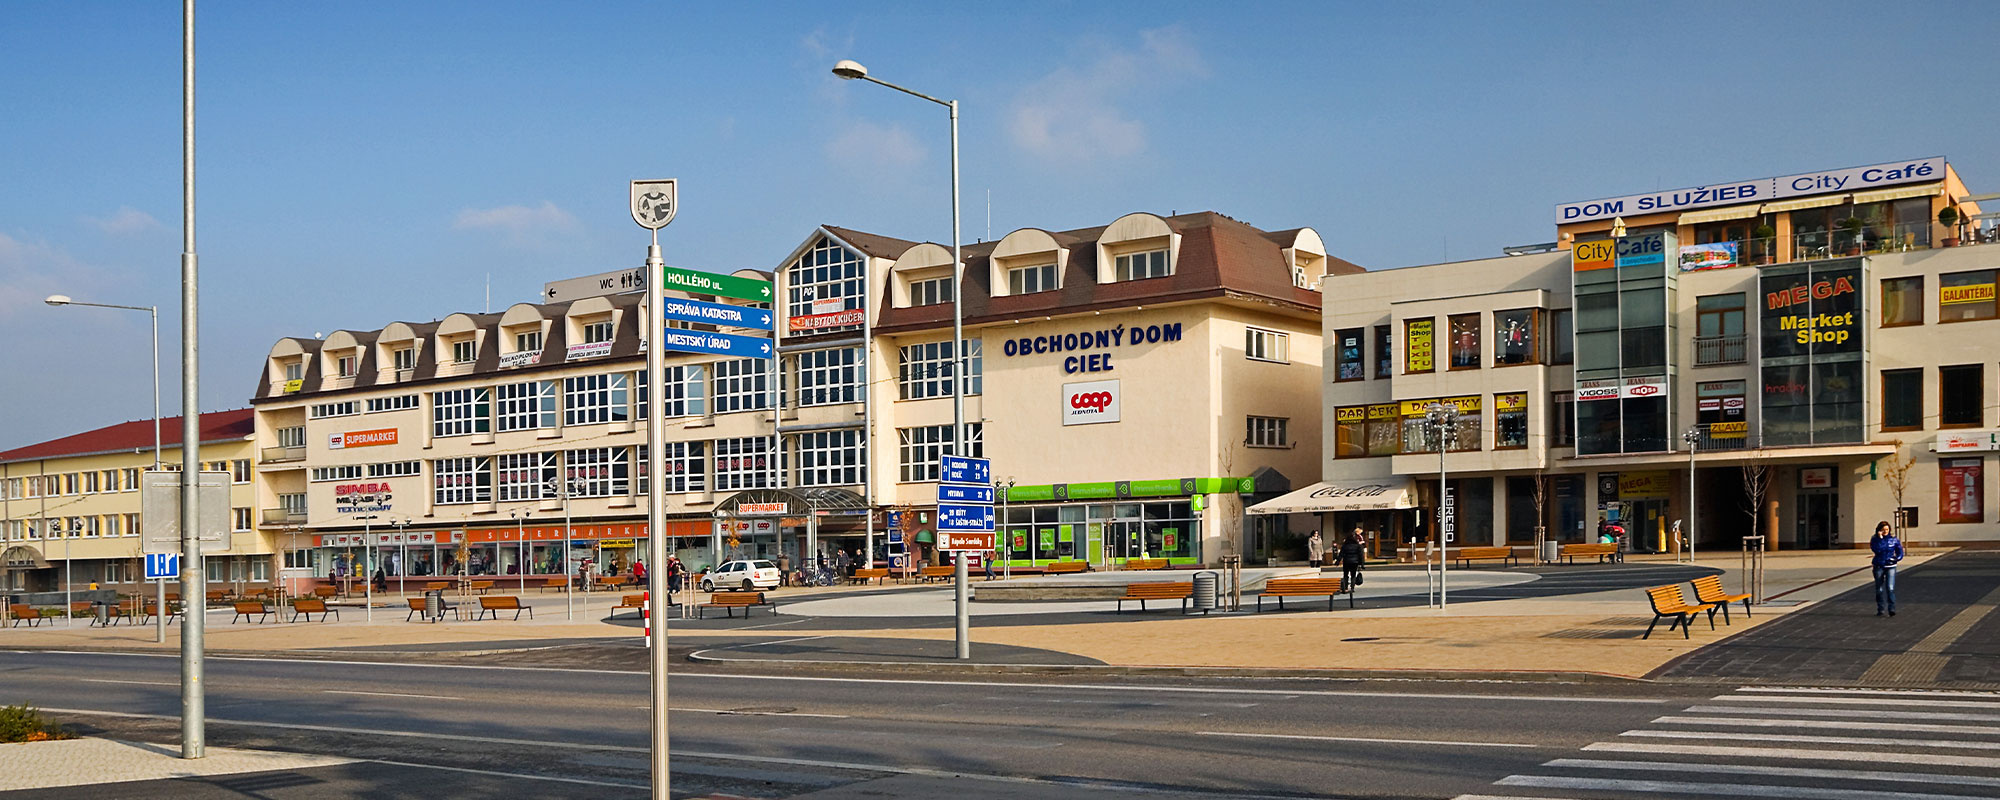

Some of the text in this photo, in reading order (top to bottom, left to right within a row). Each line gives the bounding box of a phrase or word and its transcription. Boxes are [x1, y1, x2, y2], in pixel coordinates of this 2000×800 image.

[1564, 162, 1933, 220] DOM SLUŽIEB City Café
[1577, 235, 1662, 262] City Café
[600, 279, 613, 289] WC
[668, 272, 711, 288] HOLLÉHO
[1767, 277, 1854, 310] MEGA
[1944, 287, 1993, 301] GALANTÉRIA
[667, 302, 742, 321] SPRÁVA KATASTRA
[838, 311, 865, 324] KUČER
[1780, 312, 1853, 330] Market
[667, 333, 730, 350] MESTSKÝ ÚRAD
[1004, 322, 1182, 357] OBCHODNÝ DOM
[1797, 329, 1848, 344] Shop
[1064, 353, 1113, 374] CIEĽ
[1579, 388, 1618, 396] VIGOSS
[347, 431, 395, 445] SUPERMARKET
[336, 482, 392, 496] SIMBA
[739, 503, 784, 513] SUPERMARKET
[1445, 487, 1454, 542] LIBRESO
